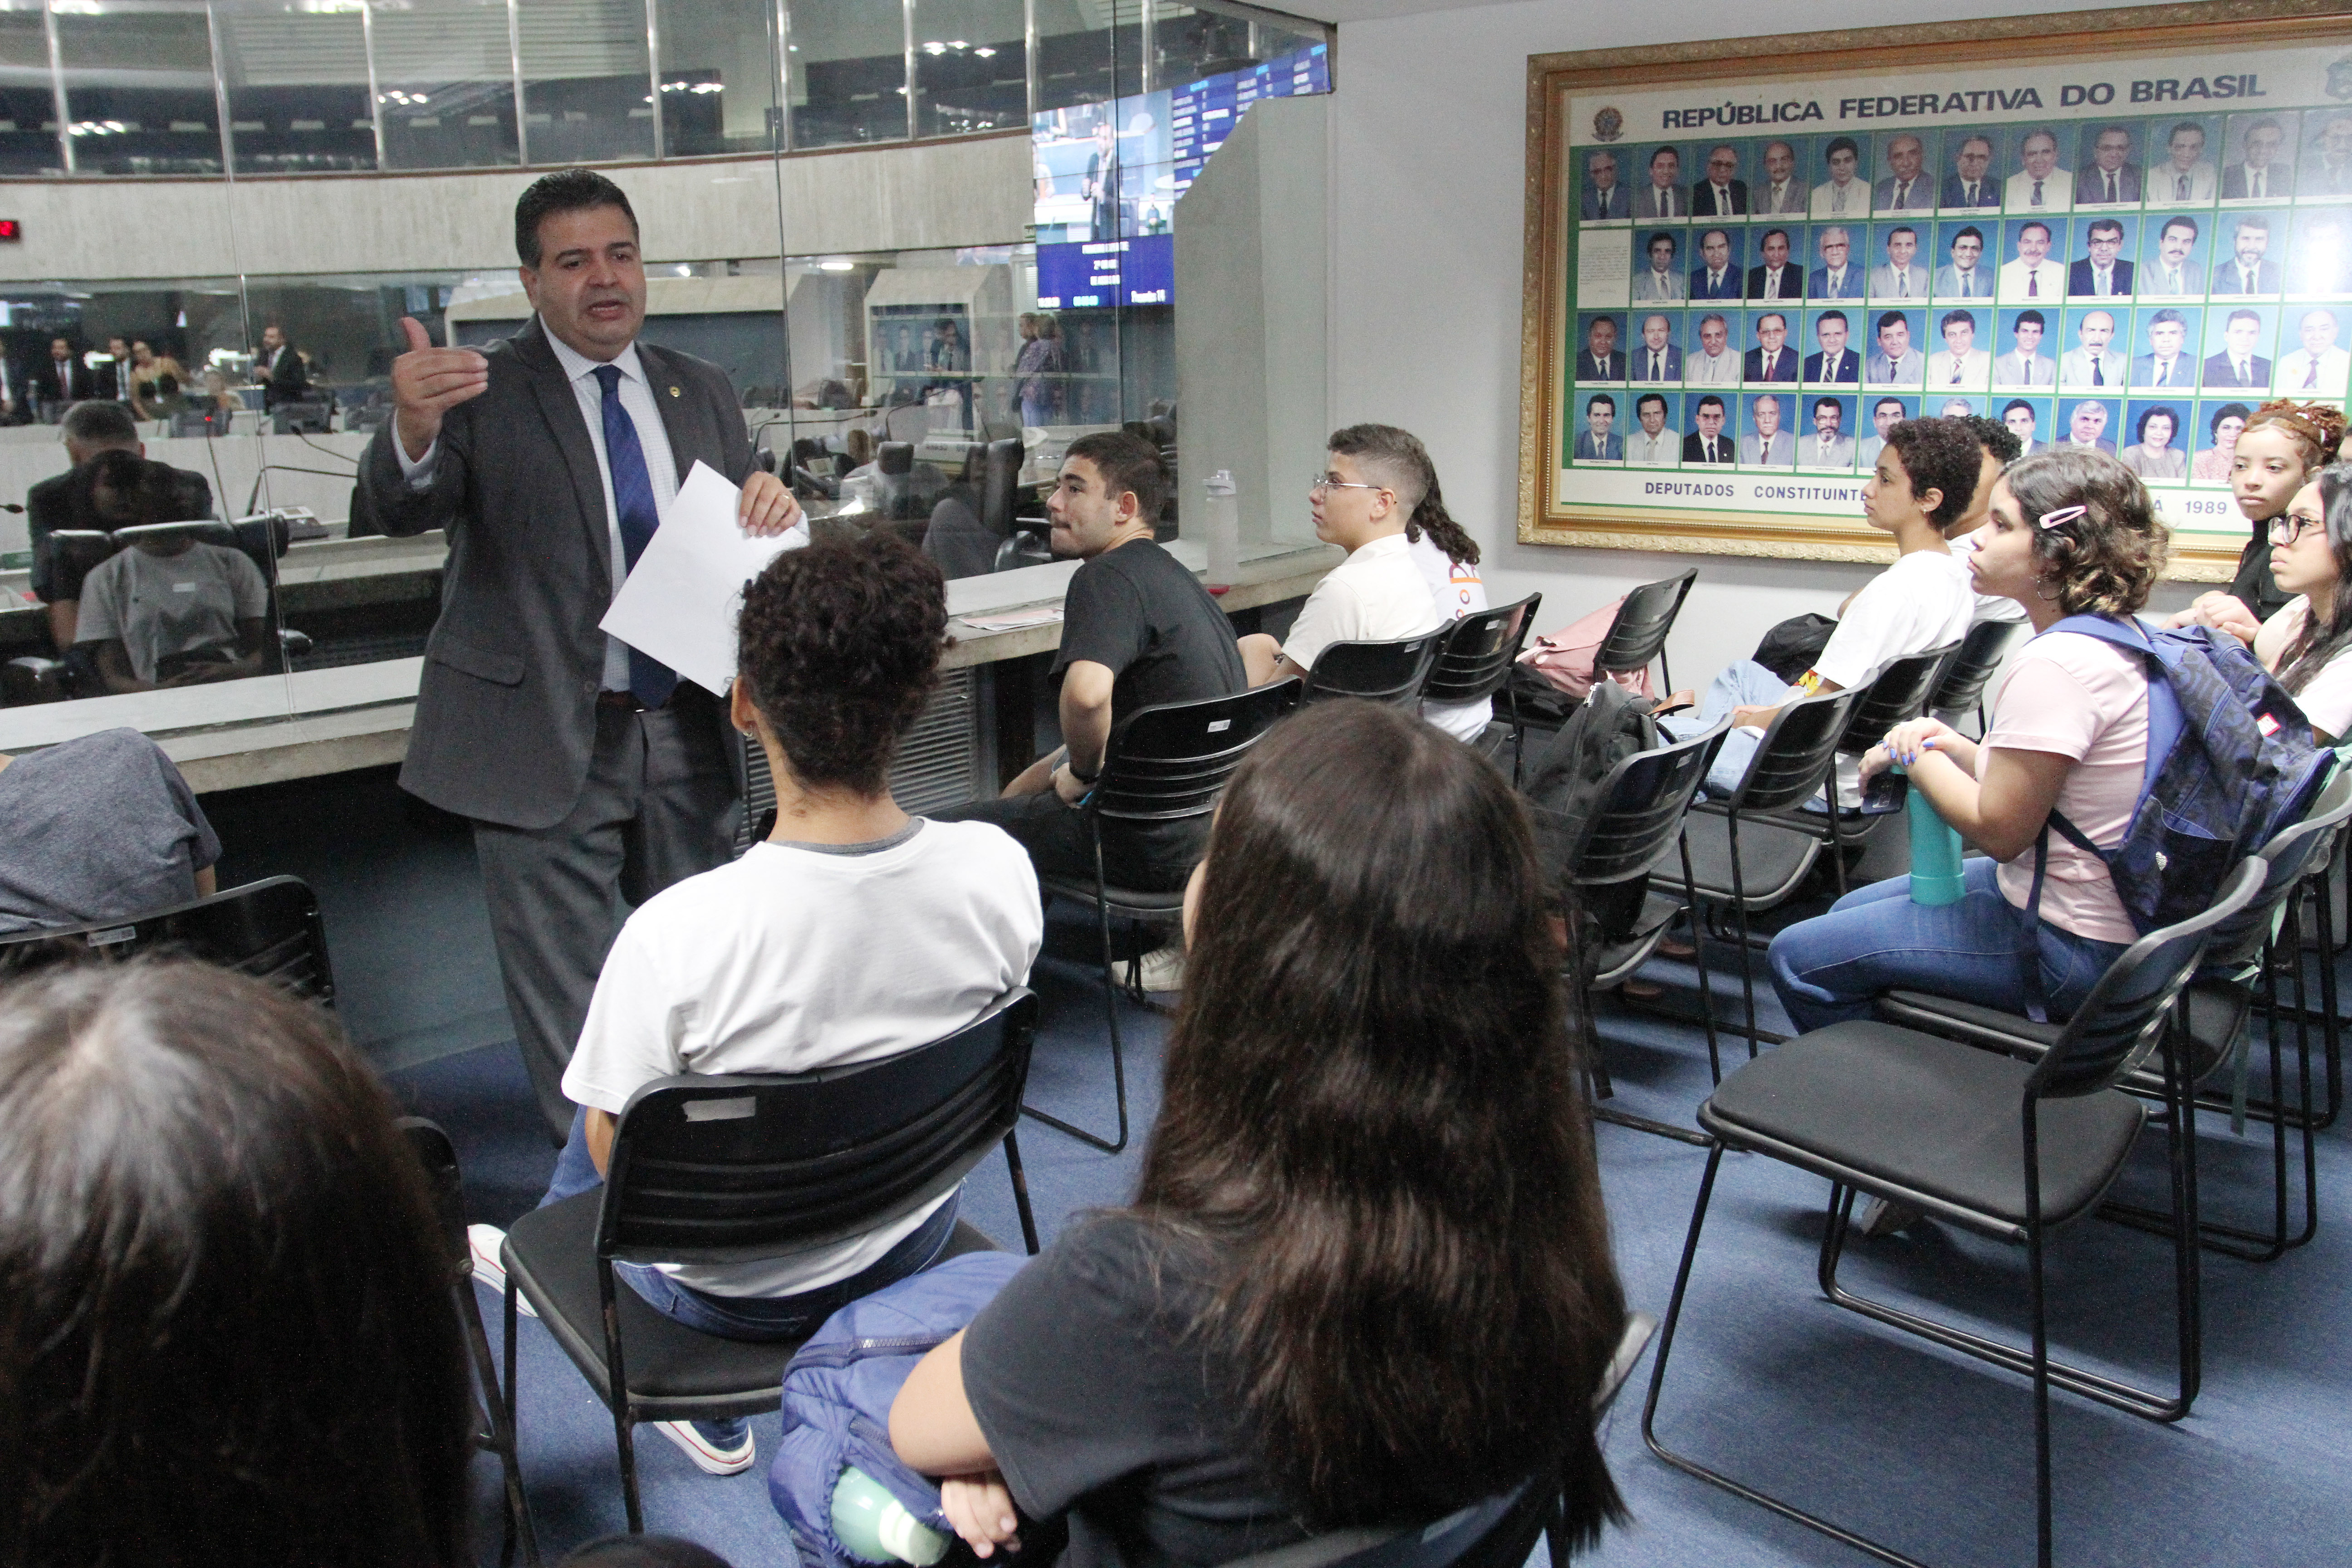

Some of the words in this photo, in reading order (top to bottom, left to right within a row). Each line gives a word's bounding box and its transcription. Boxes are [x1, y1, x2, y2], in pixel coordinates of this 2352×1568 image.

[1662, 101, 1824, 129] REPÚBLICA
[1839, 88, 2043, 119] FEDERATIVA
[2060, 83, 2115, 107] DO
[2130, 74, 2267, 103] BRASIL
[1645, 482, 1734, 496] DEPUTADOS
[2185, 500, 2227, 514] 1989
